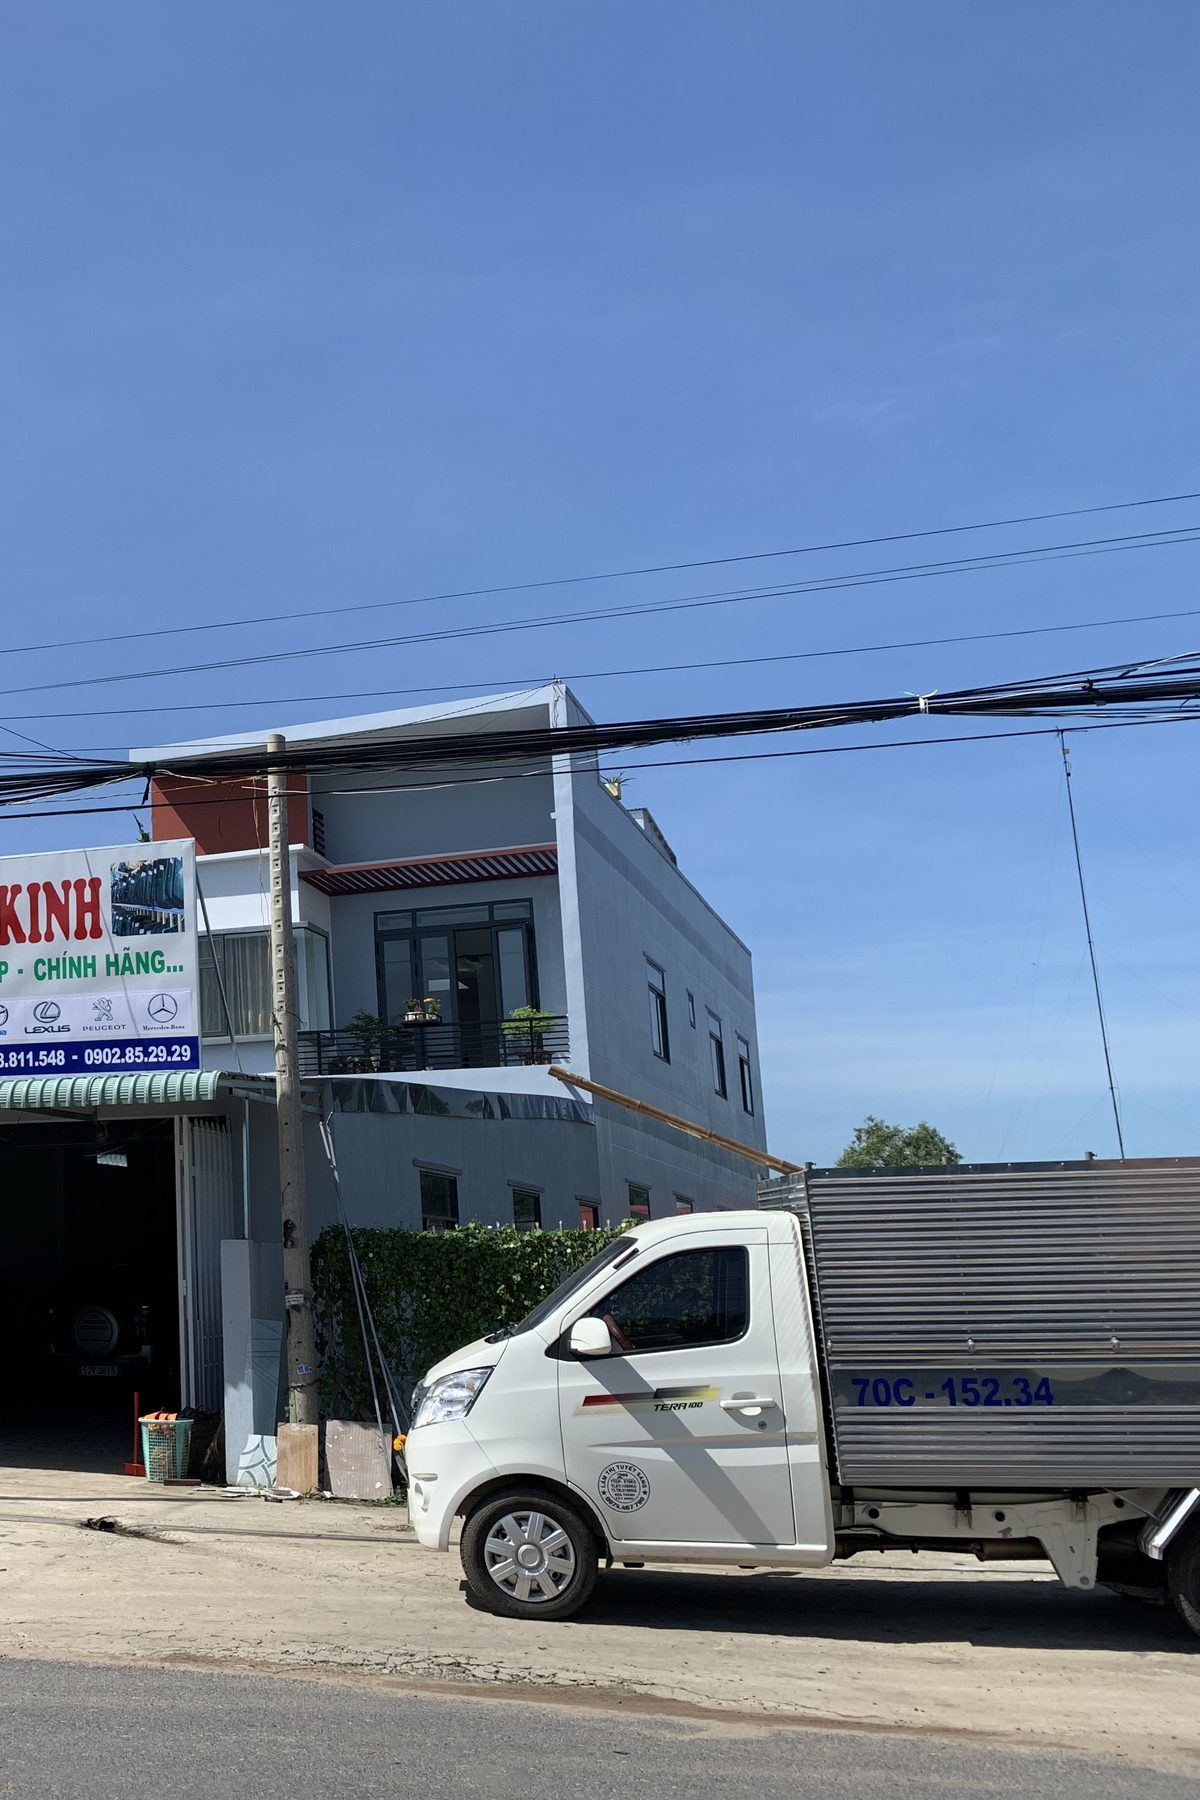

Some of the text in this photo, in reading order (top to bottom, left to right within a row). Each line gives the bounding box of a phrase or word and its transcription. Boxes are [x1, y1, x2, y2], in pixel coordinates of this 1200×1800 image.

[33, 951, 97, 981] CHÍNH
[105, 946, 184, 977] HÃNG...
[24, 1025, 71, 1034] LEXUS
[82, 1024, 127, 1032] PEUGEOT
[84, 1044, 191, 1065] 0902.85.29.29
[851, 1377, 916, 1406] 70C
[942, 1377, 1054, 1406] 152.34
[654, 1402, 688, 1412] TERA
